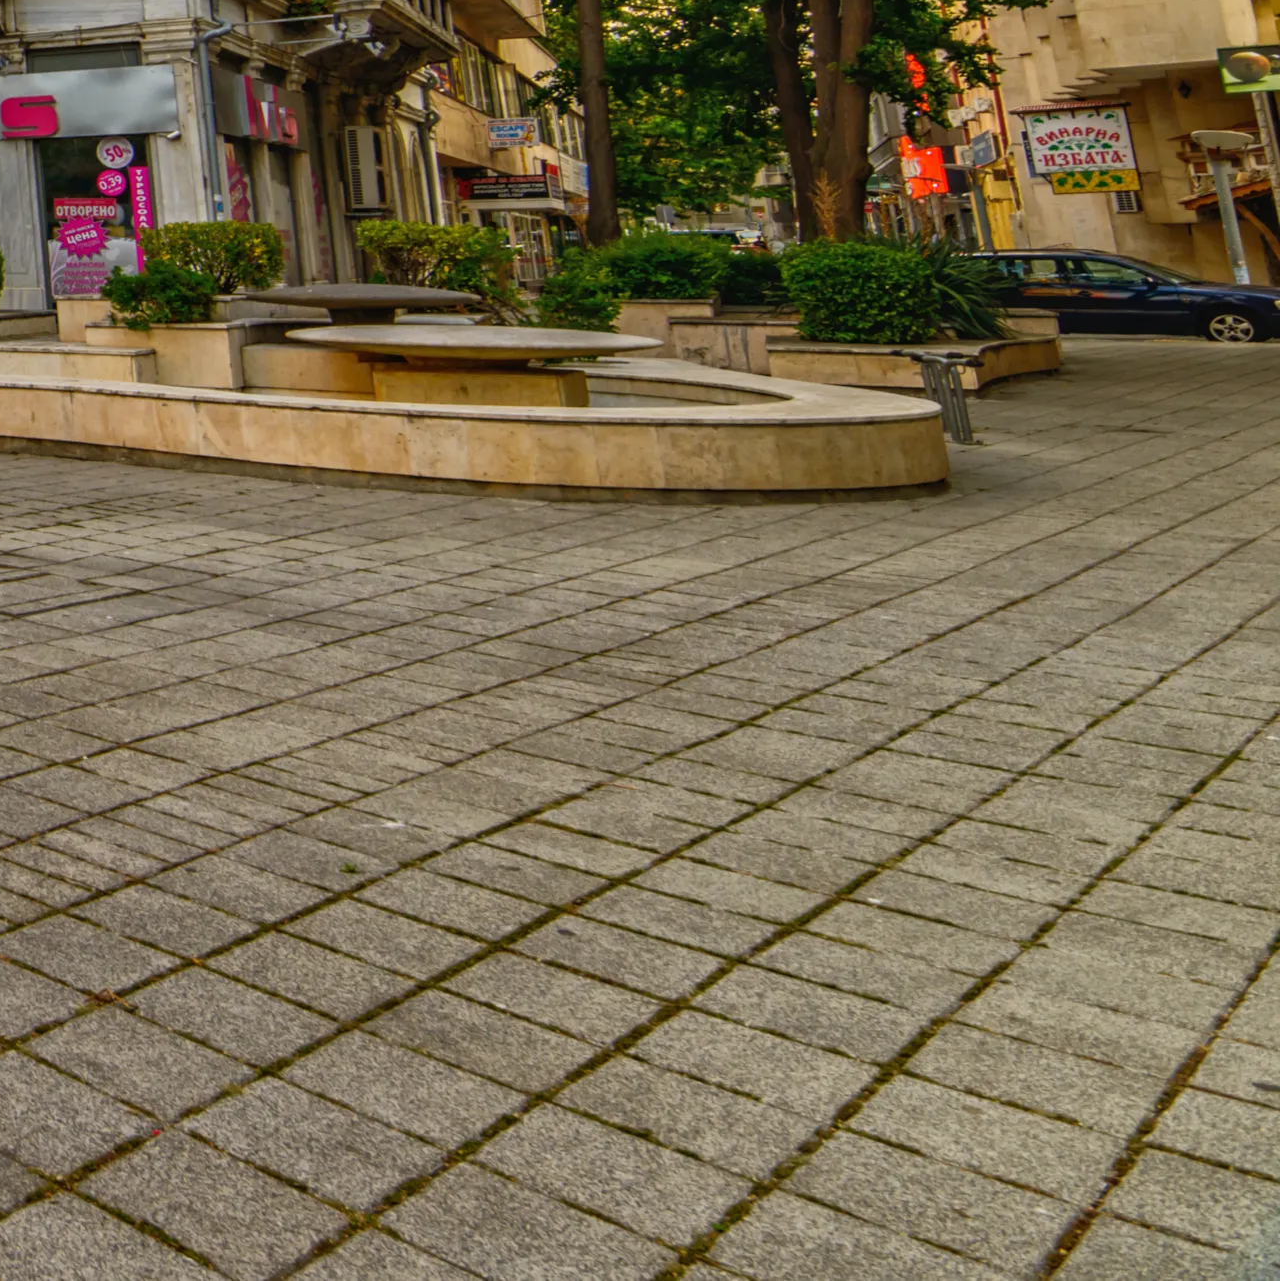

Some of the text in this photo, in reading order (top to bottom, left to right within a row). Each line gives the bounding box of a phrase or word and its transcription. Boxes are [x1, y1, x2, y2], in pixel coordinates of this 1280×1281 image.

[1035, 127, 1120, 146] ВИНАРНА
[56, 205, 115, 216] ОТВОРЕНО
[66, 230, 98, 244] цена
